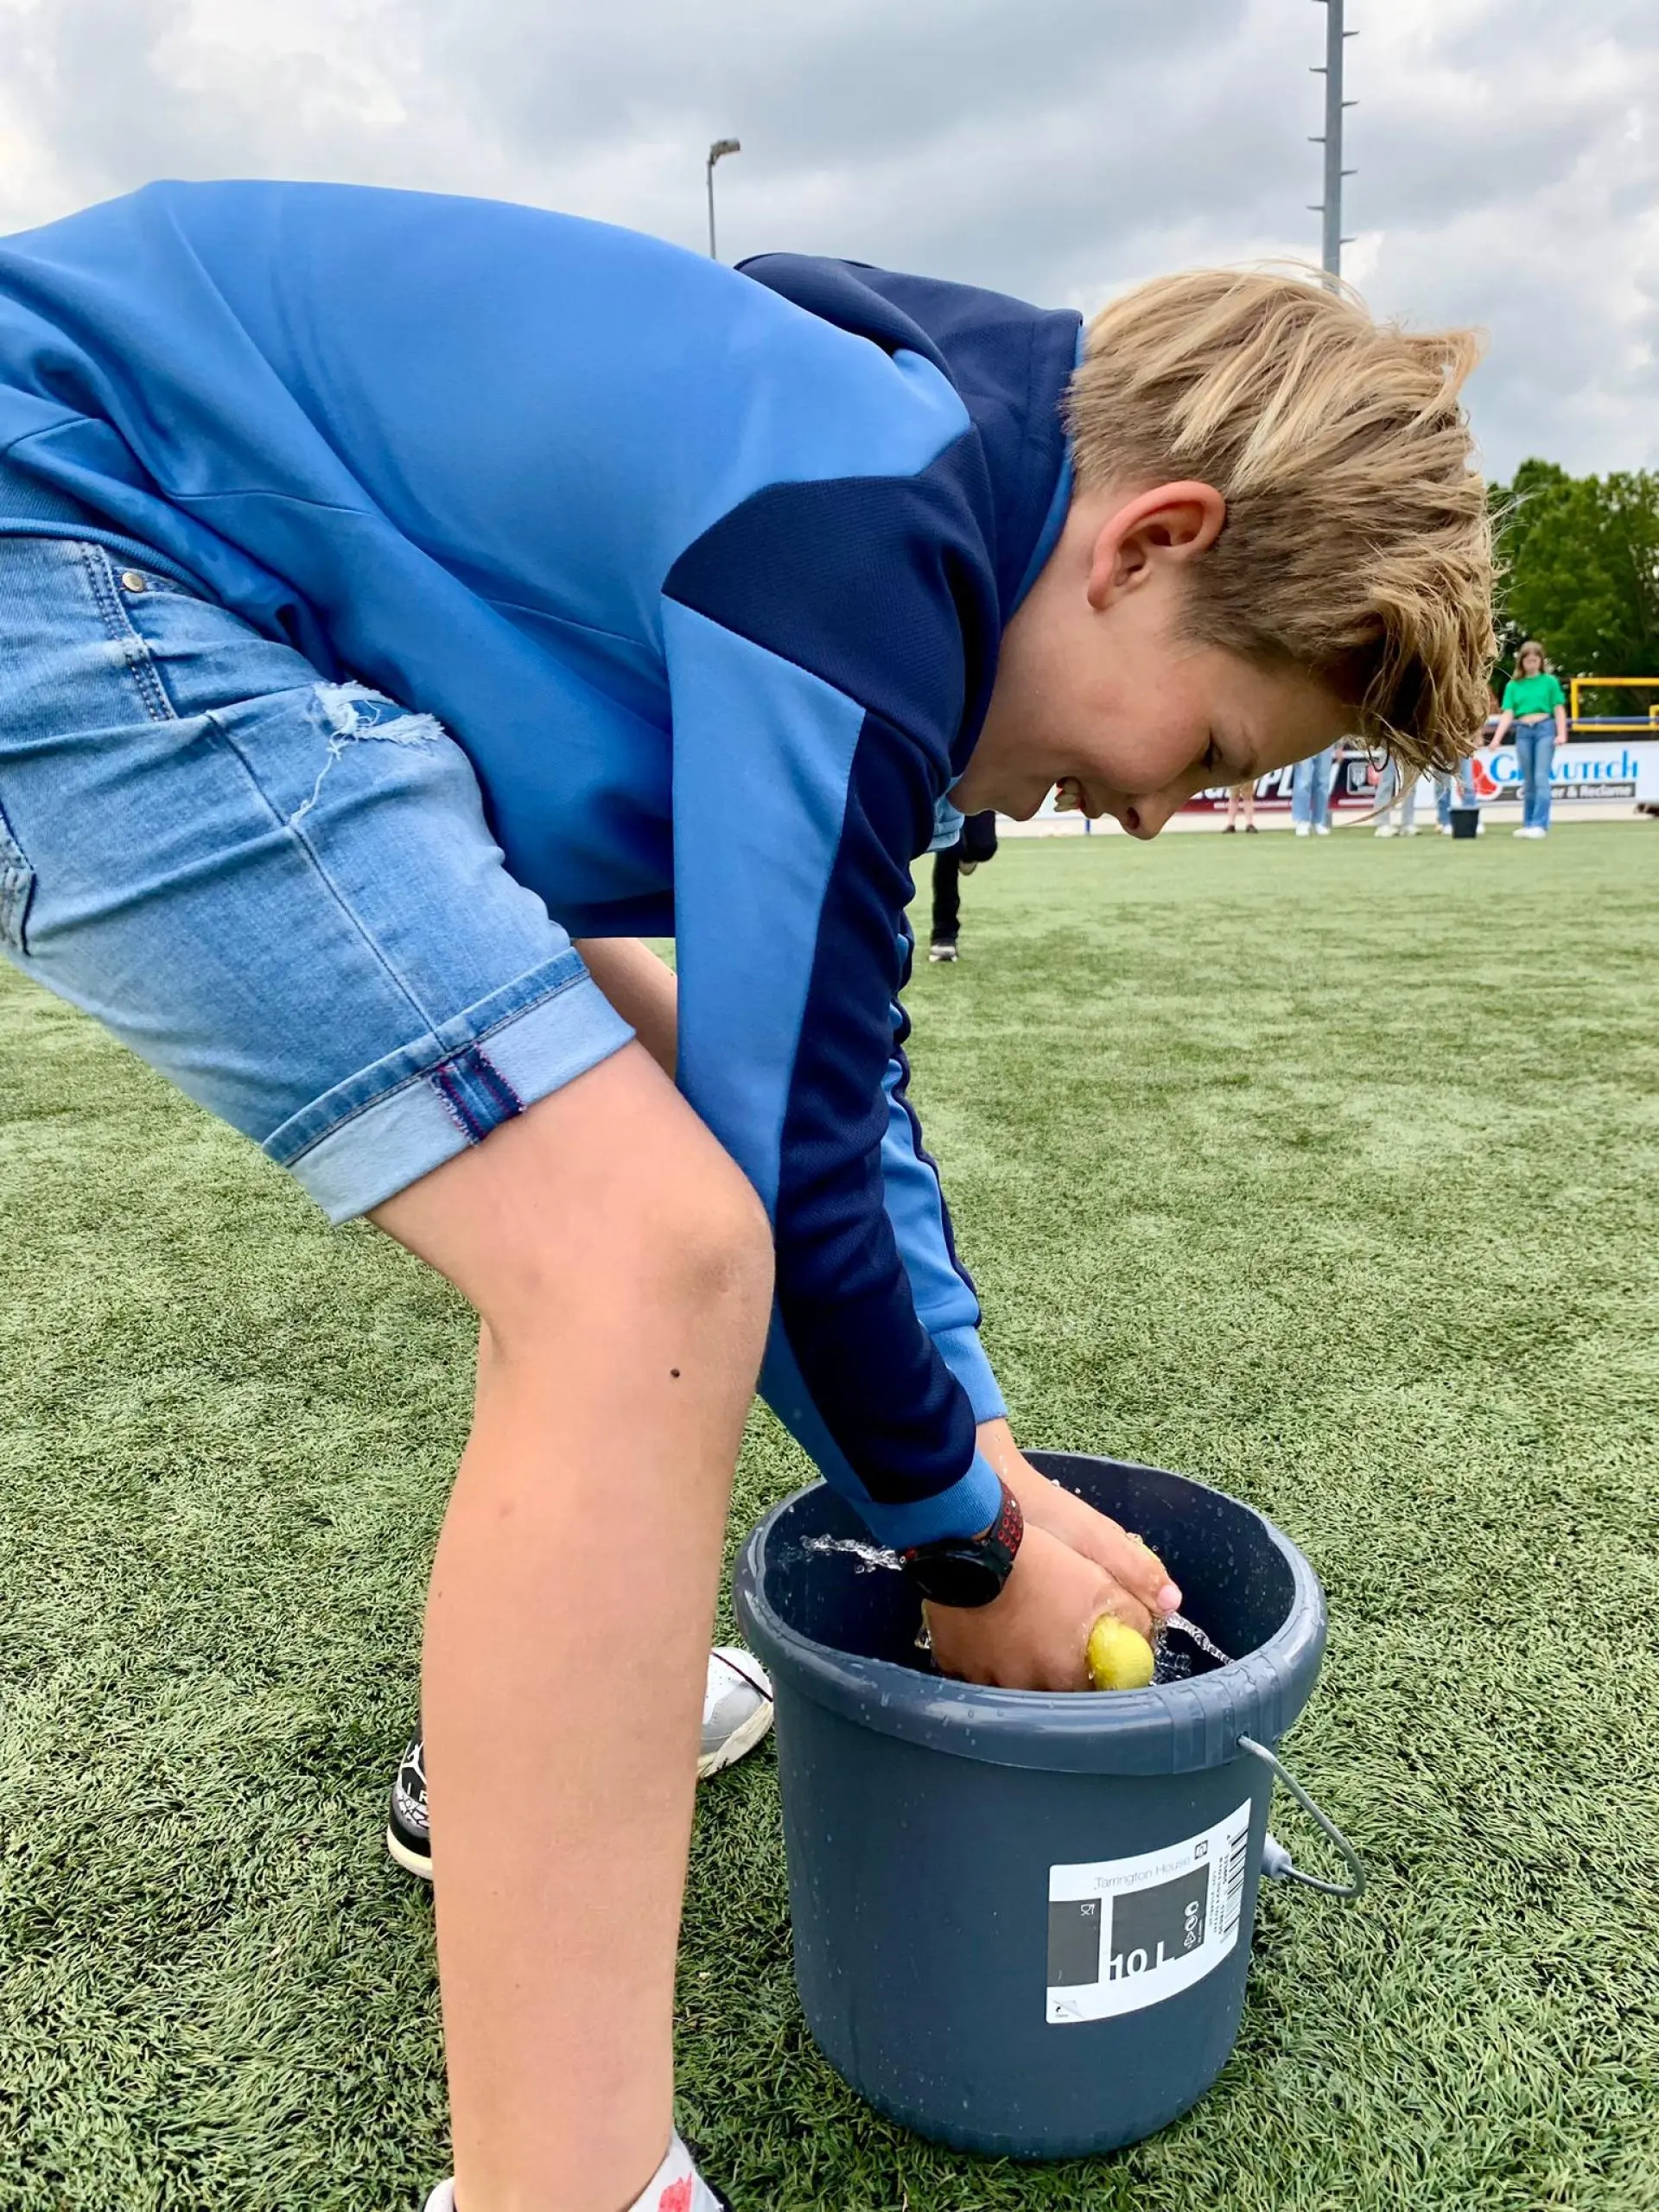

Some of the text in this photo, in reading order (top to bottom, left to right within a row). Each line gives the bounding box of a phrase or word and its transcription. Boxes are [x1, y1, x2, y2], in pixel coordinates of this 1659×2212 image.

[1580, 784, 1632, 798] Reclame
[1096, 1857, 1191, 1889] Tarrington House
[1109, 1948, 1148, 1980] 10
